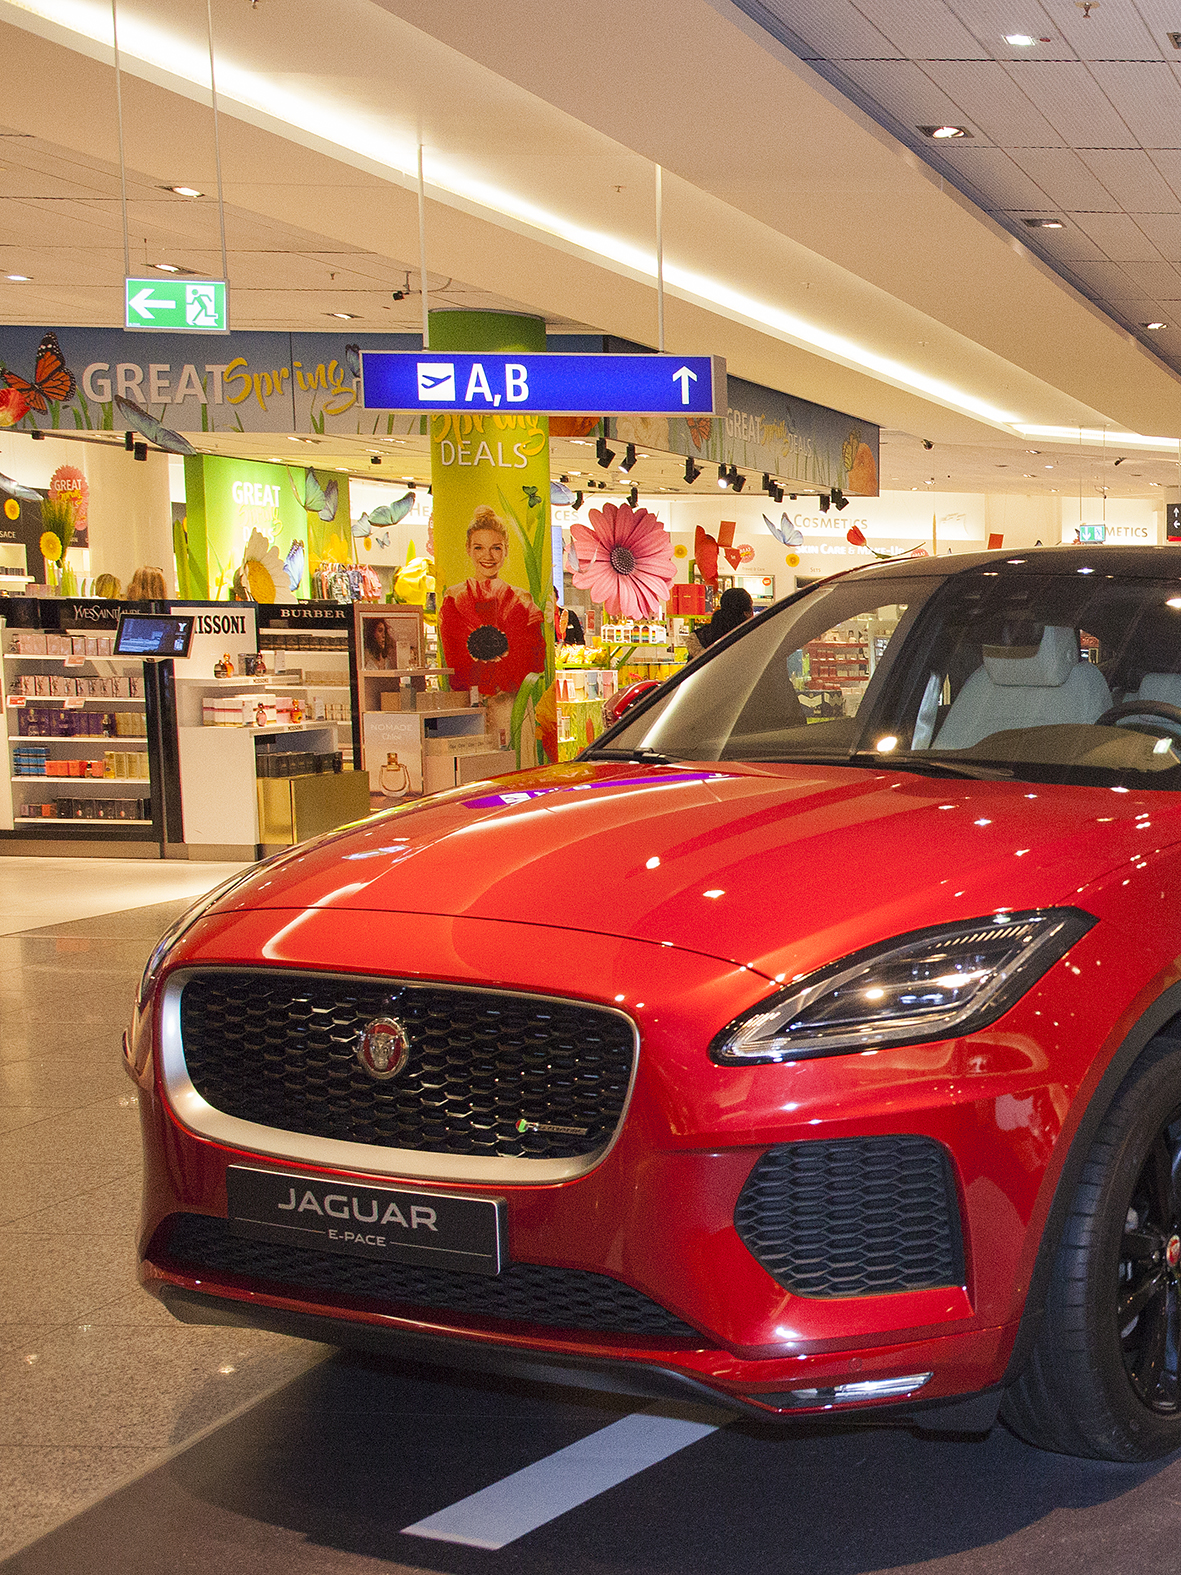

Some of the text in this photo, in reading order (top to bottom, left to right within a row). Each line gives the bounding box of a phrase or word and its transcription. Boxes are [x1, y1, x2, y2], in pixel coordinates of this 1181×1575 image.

[82, 357, 358, 415] GREAT Spring
[465, 363, 529, 407] A,B
[726, 408, 763, 445] GREAT
[440, 439, 528, 469] DEALS
[54, 479, 82, 491] GREAT
[232, 480, 280, 507] GREAT
[793, 514, 868, 529] COSMETICS
[795, 545, 819, 554] SKIN
[820, 544, 846, 555] CARE
[848, 546, 854, 555] &
[195, 615, 246, 634] ISSONI
[280, 608, 346, 618] BURBER
[278, 1188, 438, 1232] JAGUAR
[328, 1229, 386, 1247] E-PACE
